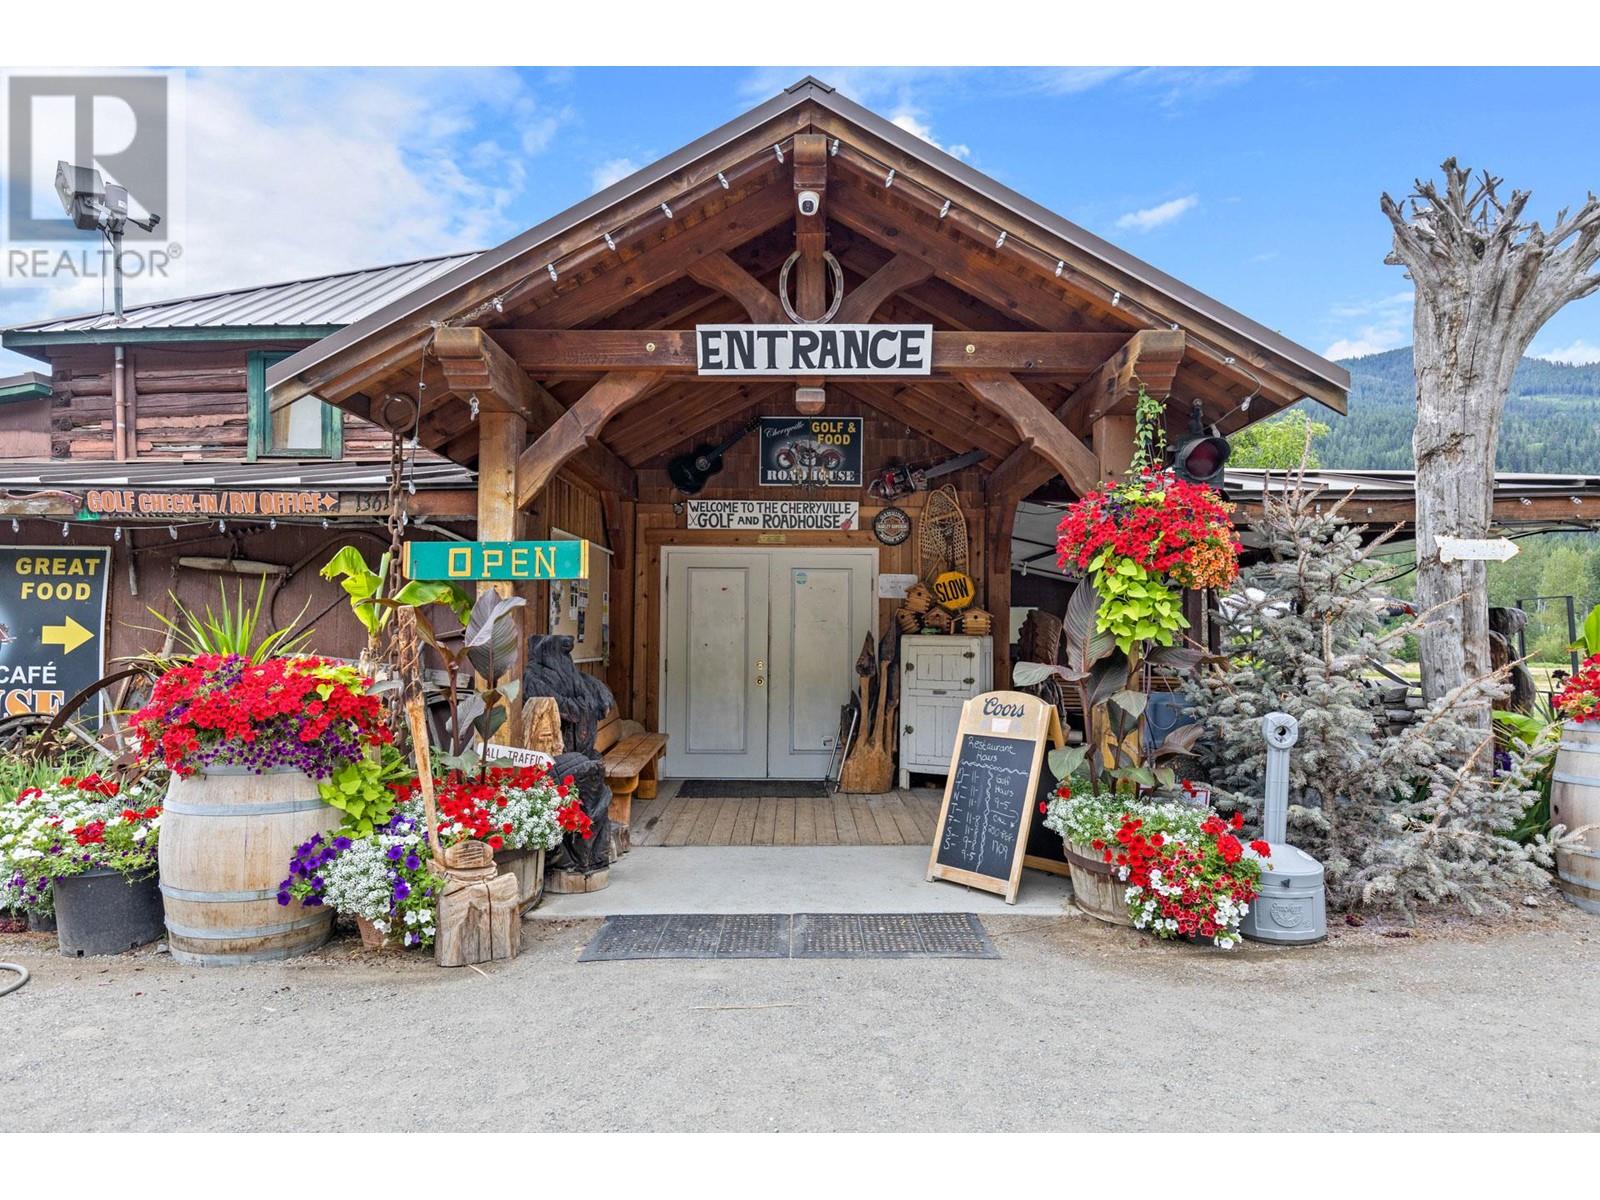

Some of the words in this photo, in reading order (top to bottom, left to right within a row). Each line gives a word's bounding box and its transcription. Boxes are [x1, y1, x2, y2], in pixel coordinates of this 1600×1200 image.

[699, 329, 925, 370] ENTRANCE
[811, 421, 844, 433] GOLF
[847, 422, 857, 434] &
[817, 433, 851, 446] FOOD
[86, 490, 135, 513] GOLF
[259, 491, 322, 515] OFFICE
[688, 501, 739, 514] WELCOME
[740, 502, 755, 514] TO
[756, 502, 778, 514] THE
[780, 502, 852, 515] CHERRYVILLE
[697, 513, 735, 529] GOLF
[737, 515, 759, 526] AND
[762, 514, 841, 529] ROADHOUSE
[15, 557, 101, 577] GREAT
[448, 547, 557, 578] OPEN
[20, 582, 91, 601] FOOD
[935, 577, 970, 603] SLOW
[0, 660, 57, 684] CAFÉ
[983, 697, 1025, 718] Coors
